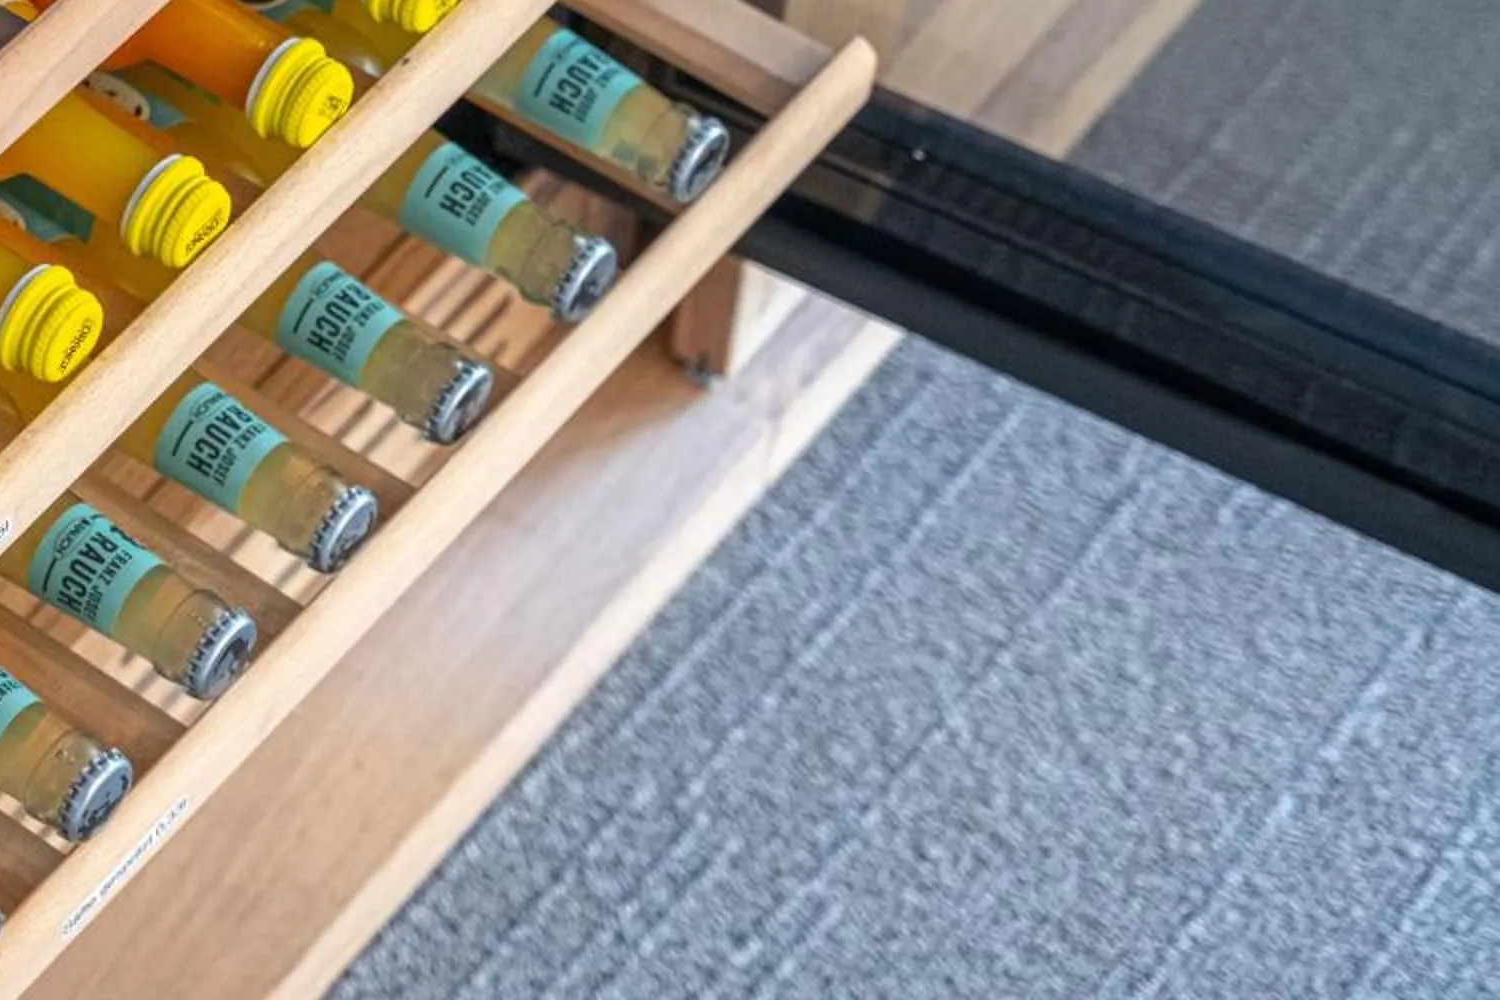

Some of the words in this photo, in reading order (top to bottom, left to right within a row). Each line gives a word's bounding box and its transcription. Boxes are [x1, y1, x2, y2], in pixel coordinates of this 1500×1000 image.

[438, 164, 495, 220] AUCH
[306, 281, 372, 354] RAUCH
[330, 325, 357, 364] JOSEF
[184, 402, 254, 479] RAUCH
[211, 447, 237, 489] JOSEF
[55, 530, 119, 612] RAUCH
[98, 548, 134, 586] FRANZ
[81, 584, 104, 621] JOSEF
